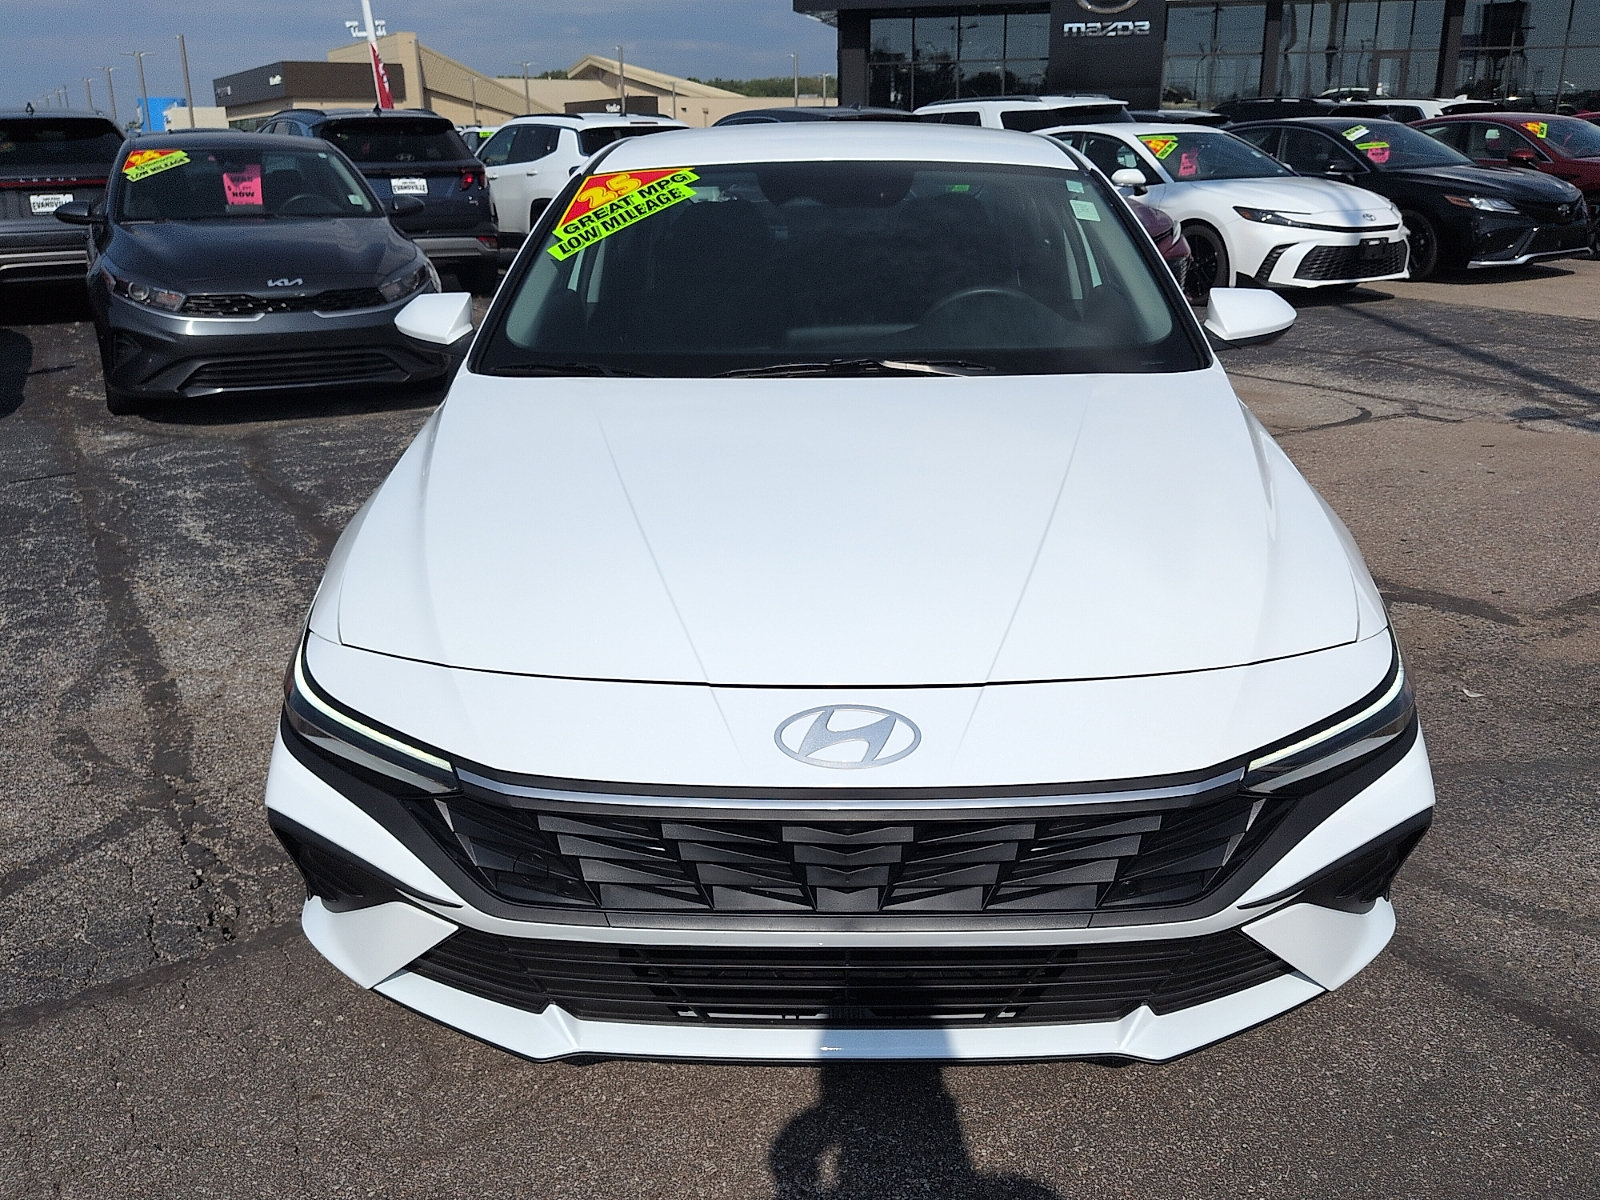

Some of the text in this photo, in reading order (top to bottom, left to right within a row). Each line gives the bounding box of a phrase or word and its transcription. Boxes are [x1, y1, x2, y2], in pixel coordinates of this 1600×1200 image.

[557, 188, 683, 254] LOW MILEAGE
[562, 173, 688, 235] GREAT MPG
[577, 173, 642, 208] 25
